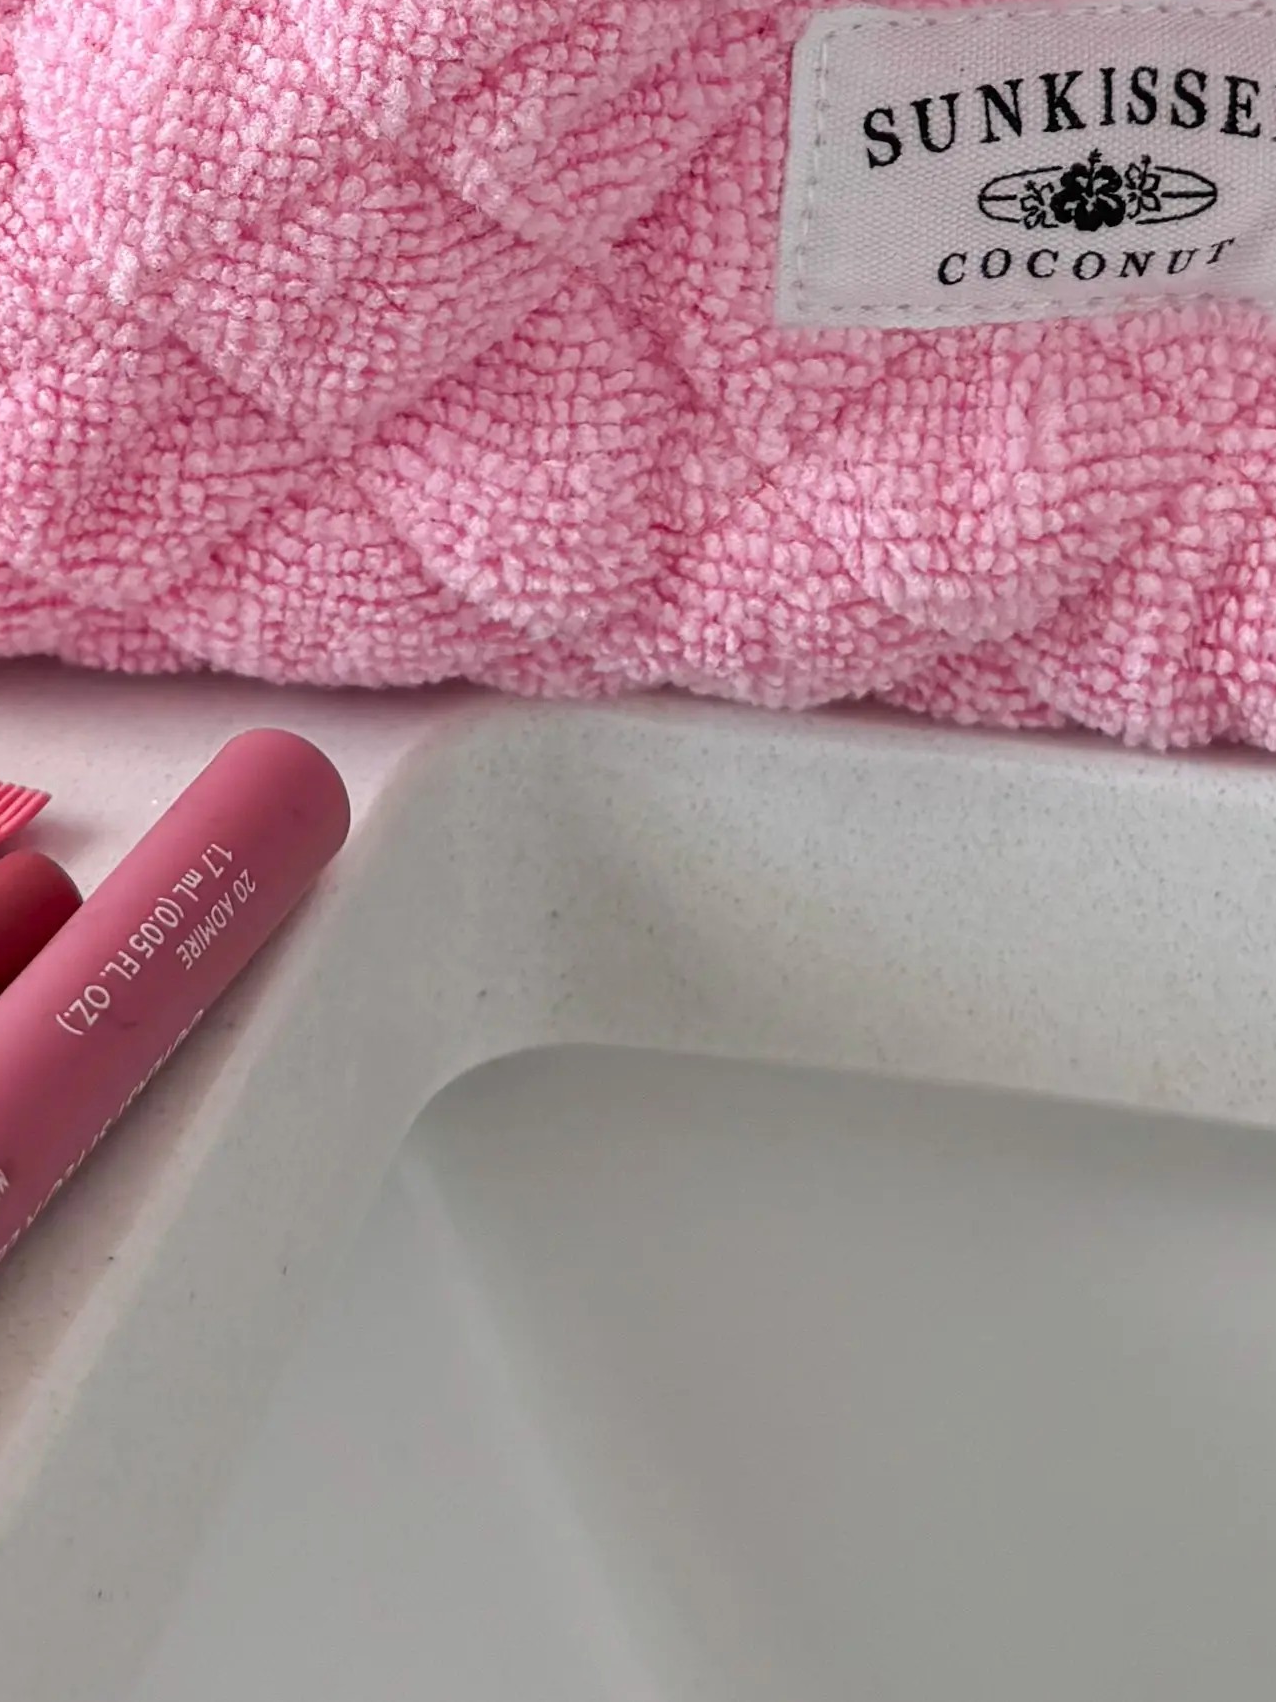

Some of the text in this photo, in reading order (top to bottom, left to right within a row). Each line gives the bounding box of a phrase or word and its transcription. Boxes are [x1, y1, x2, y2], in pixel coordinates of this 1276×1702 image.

[934, 236, 1239, 287] COCONUT
[171, 868, 204, 903] mL
[201, 843, 233, 879] 1.7
[128, 897, 185, 960] (0.05
[175, 868, 257, 971] 20 ADMIRE
[99, 950, 142, 981] FL.
[55, 984, 111, 1036] OZ.)
